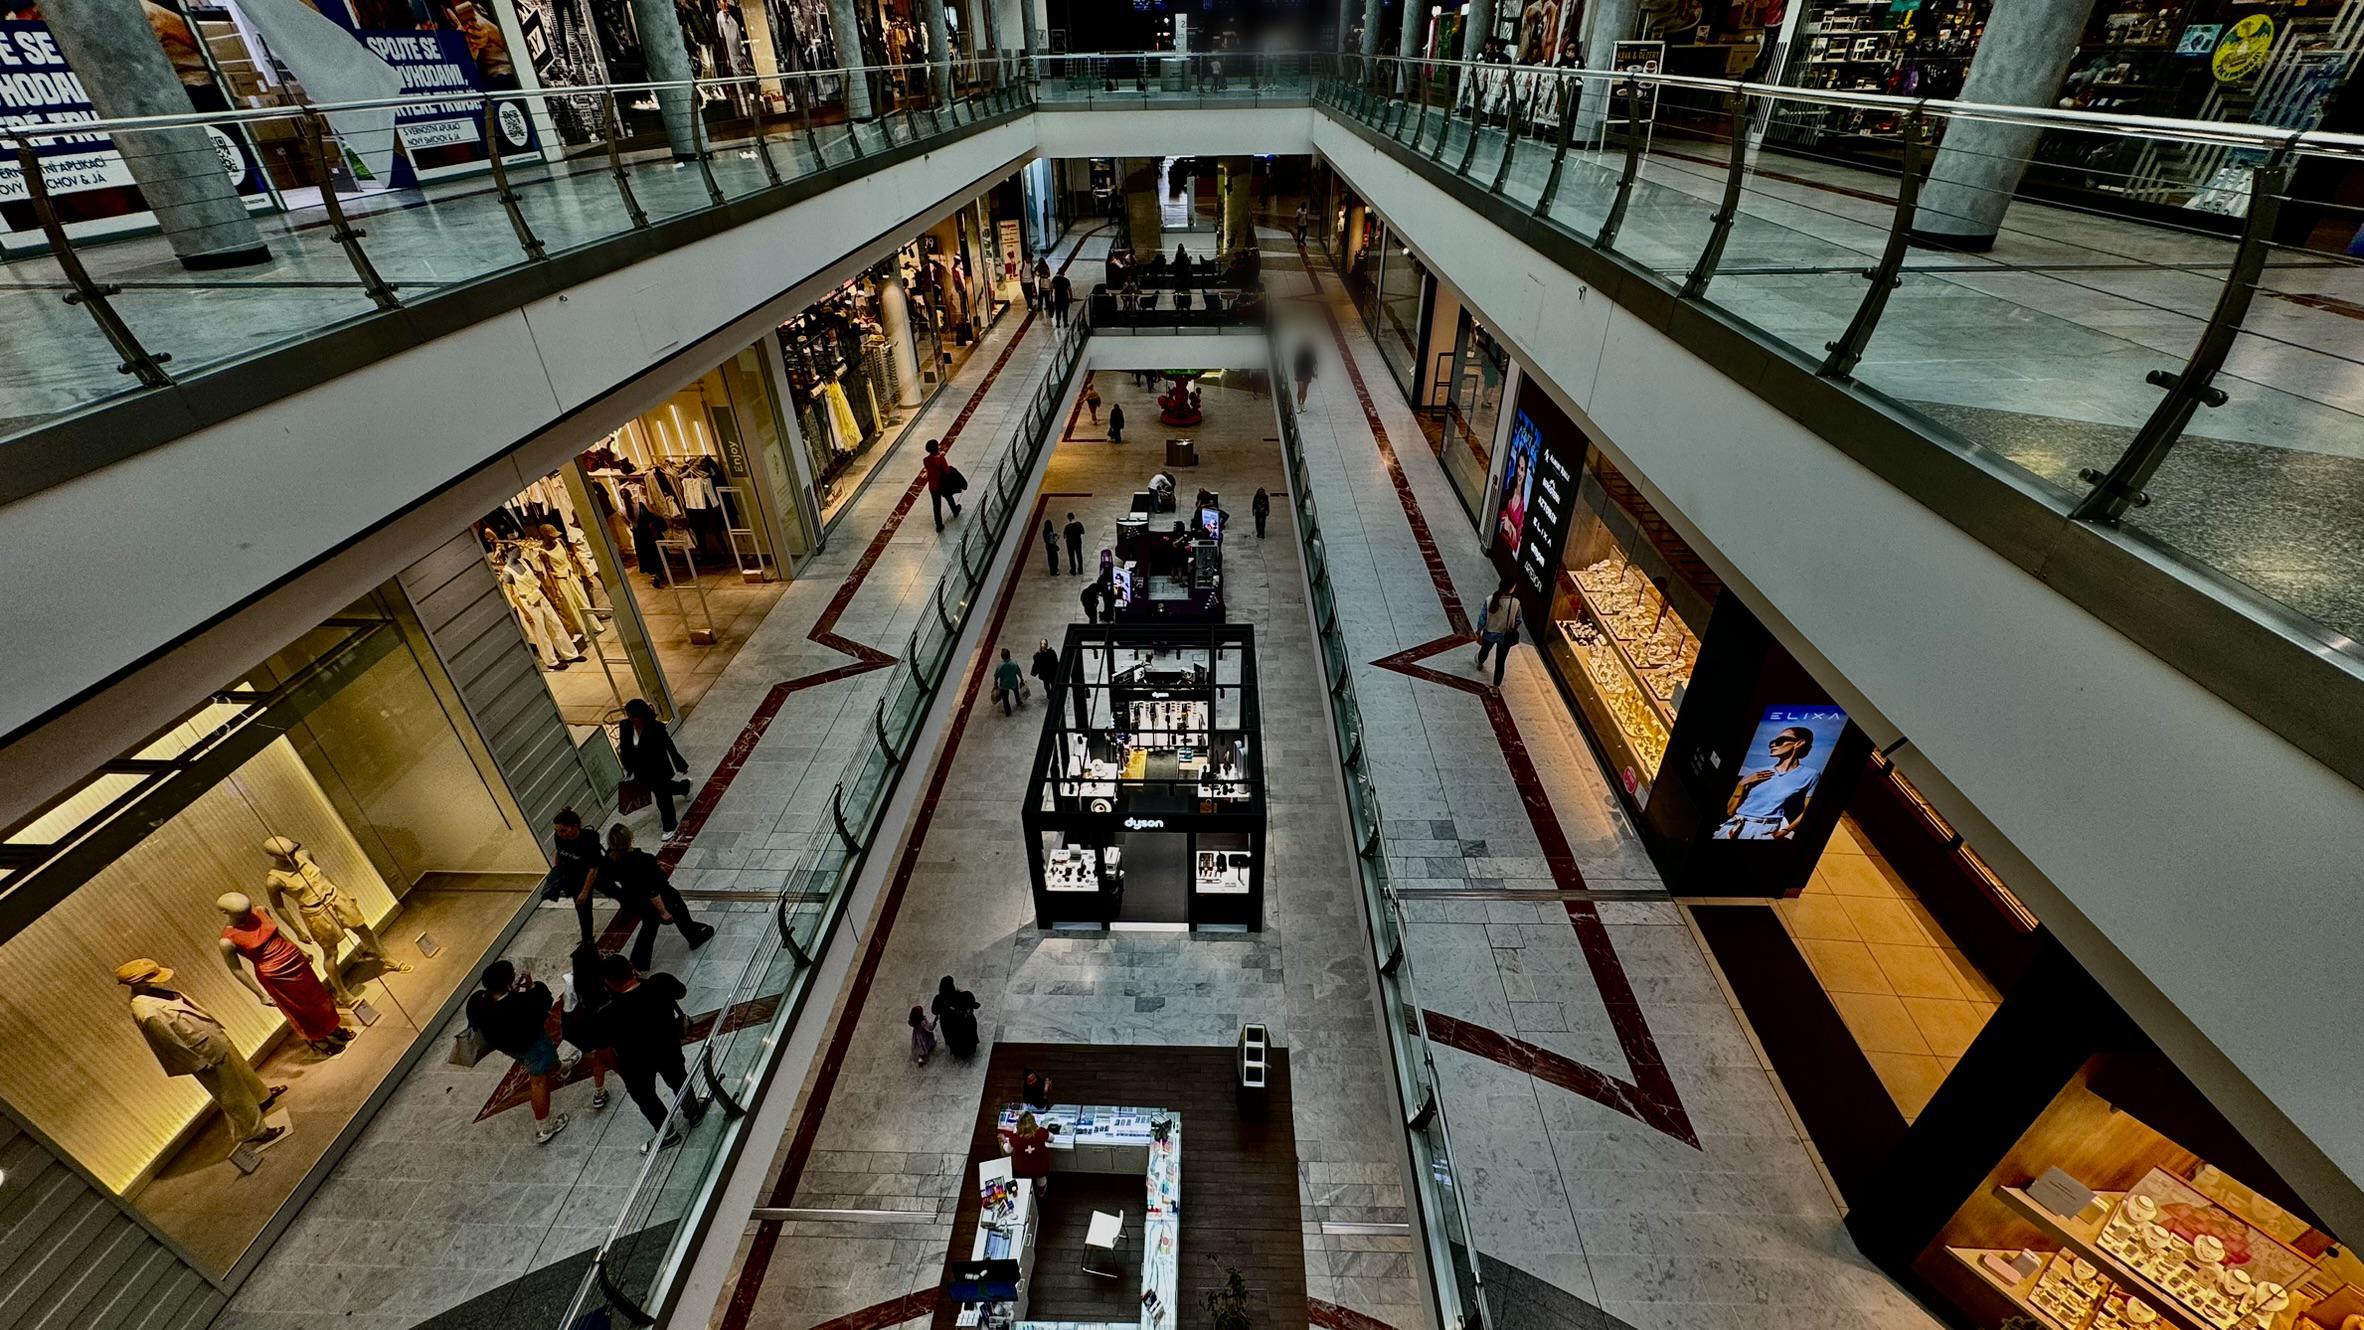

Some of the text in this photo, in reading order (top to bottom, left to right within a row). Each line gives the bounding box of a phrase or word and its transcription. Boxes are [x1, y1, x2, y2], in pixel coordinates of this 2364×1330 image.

[14, 31, 65, 65] SE
[367, 36, 442, 61] SPOJTE SE
[0, 71, 91, 108] HODA
[60, 154, 106, 173] APLIKACÍ
[80, 174, 90, 185] &
[728, 440, 744, 472] Enjoy
[1152, 691, 1170, 699] dyson
[1770, 712, 1841, 720] ELIXA
[1123, 816, 1164, 830] dyson
